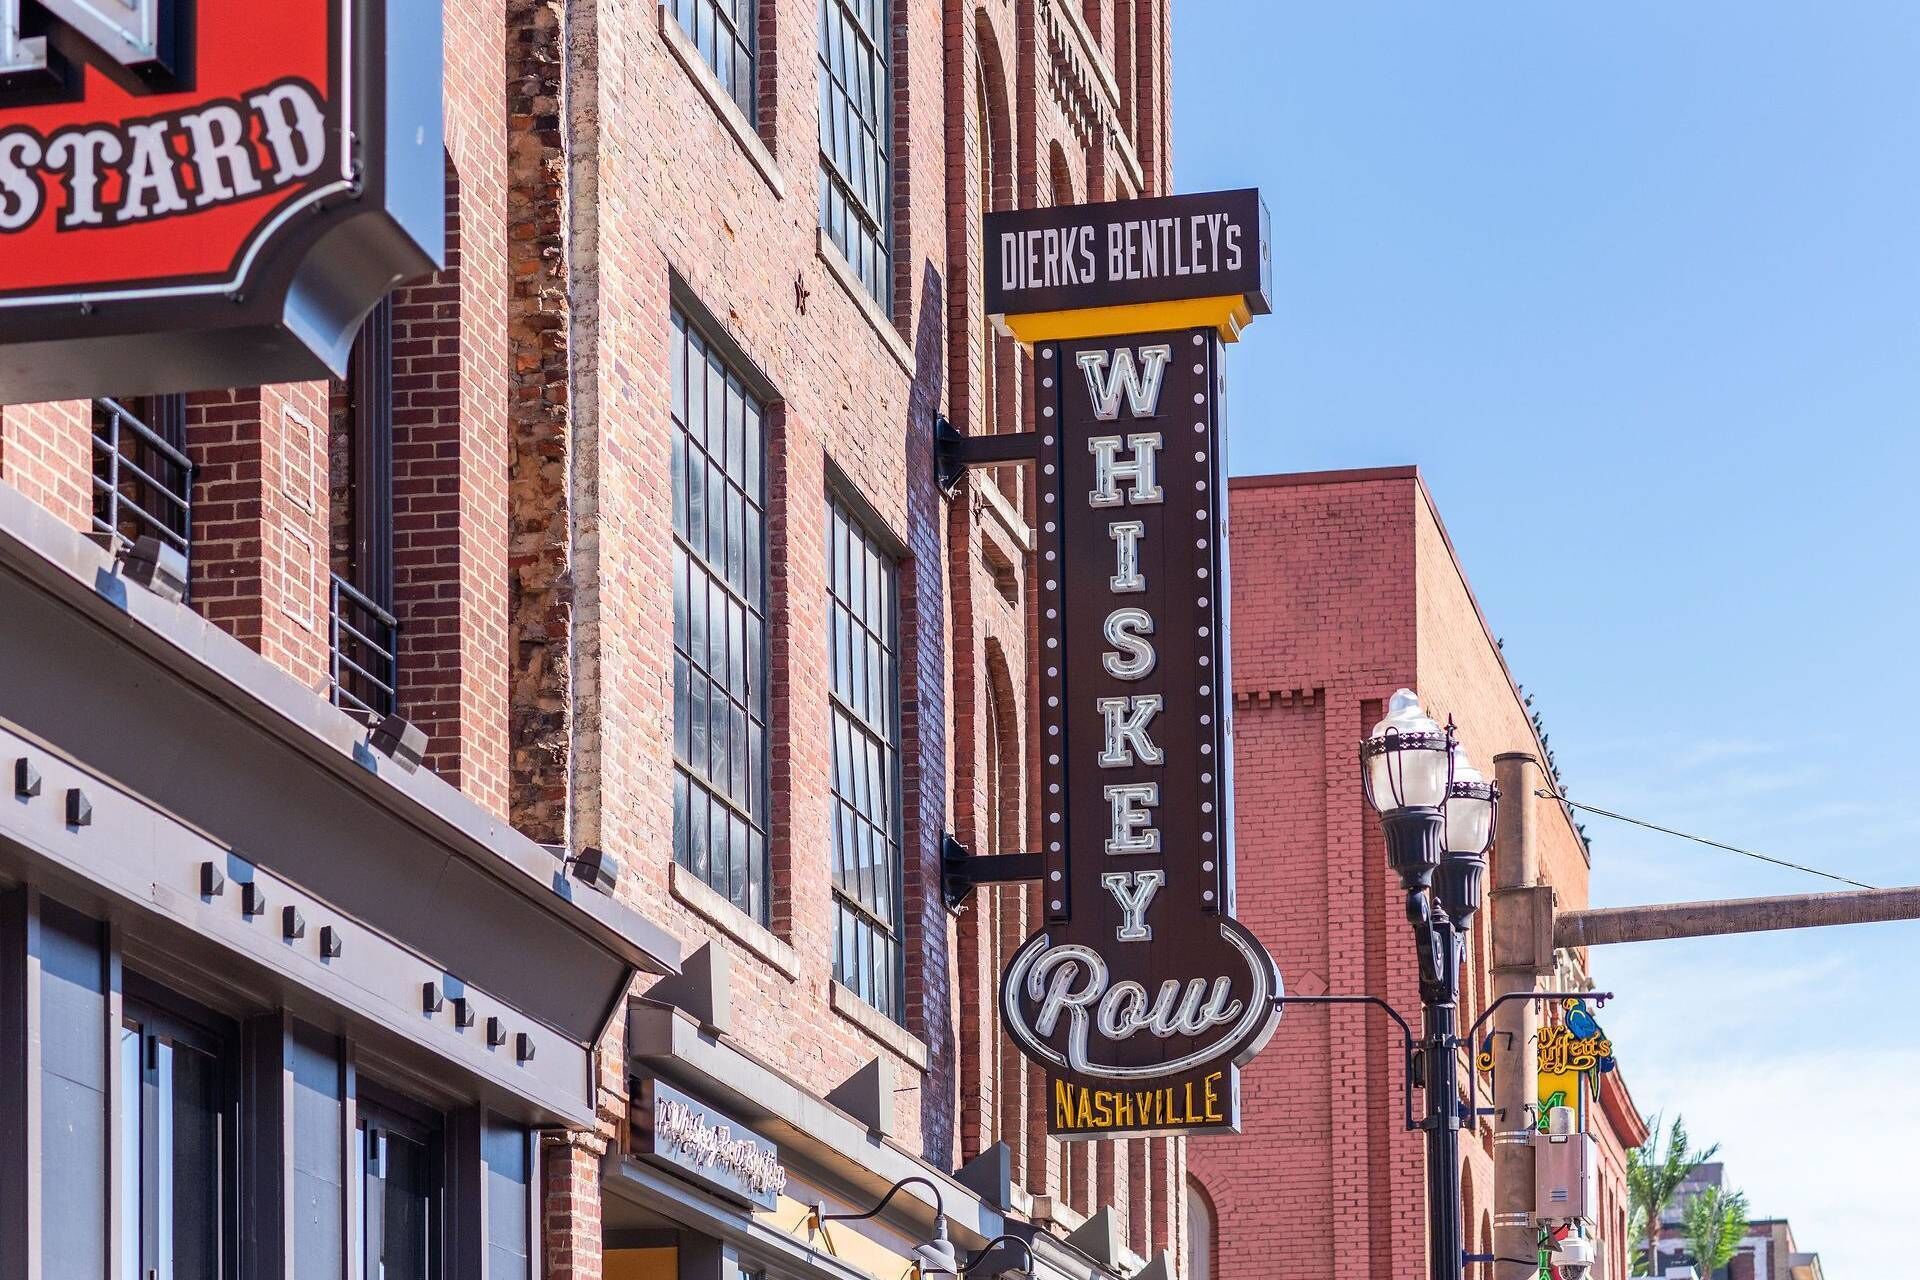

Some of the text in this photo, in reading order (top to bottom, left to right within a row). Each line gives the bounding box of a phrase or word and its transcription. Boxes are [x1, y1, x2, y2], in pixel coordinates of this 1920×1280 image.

[1001, 226, 1096, 291] DIERKS
[1075, 344, 1172, 942] WHISKEY
[1027, 944, 1243, 1079] Row
[1055, 1071, 1223, 1129] NASHVILLE
